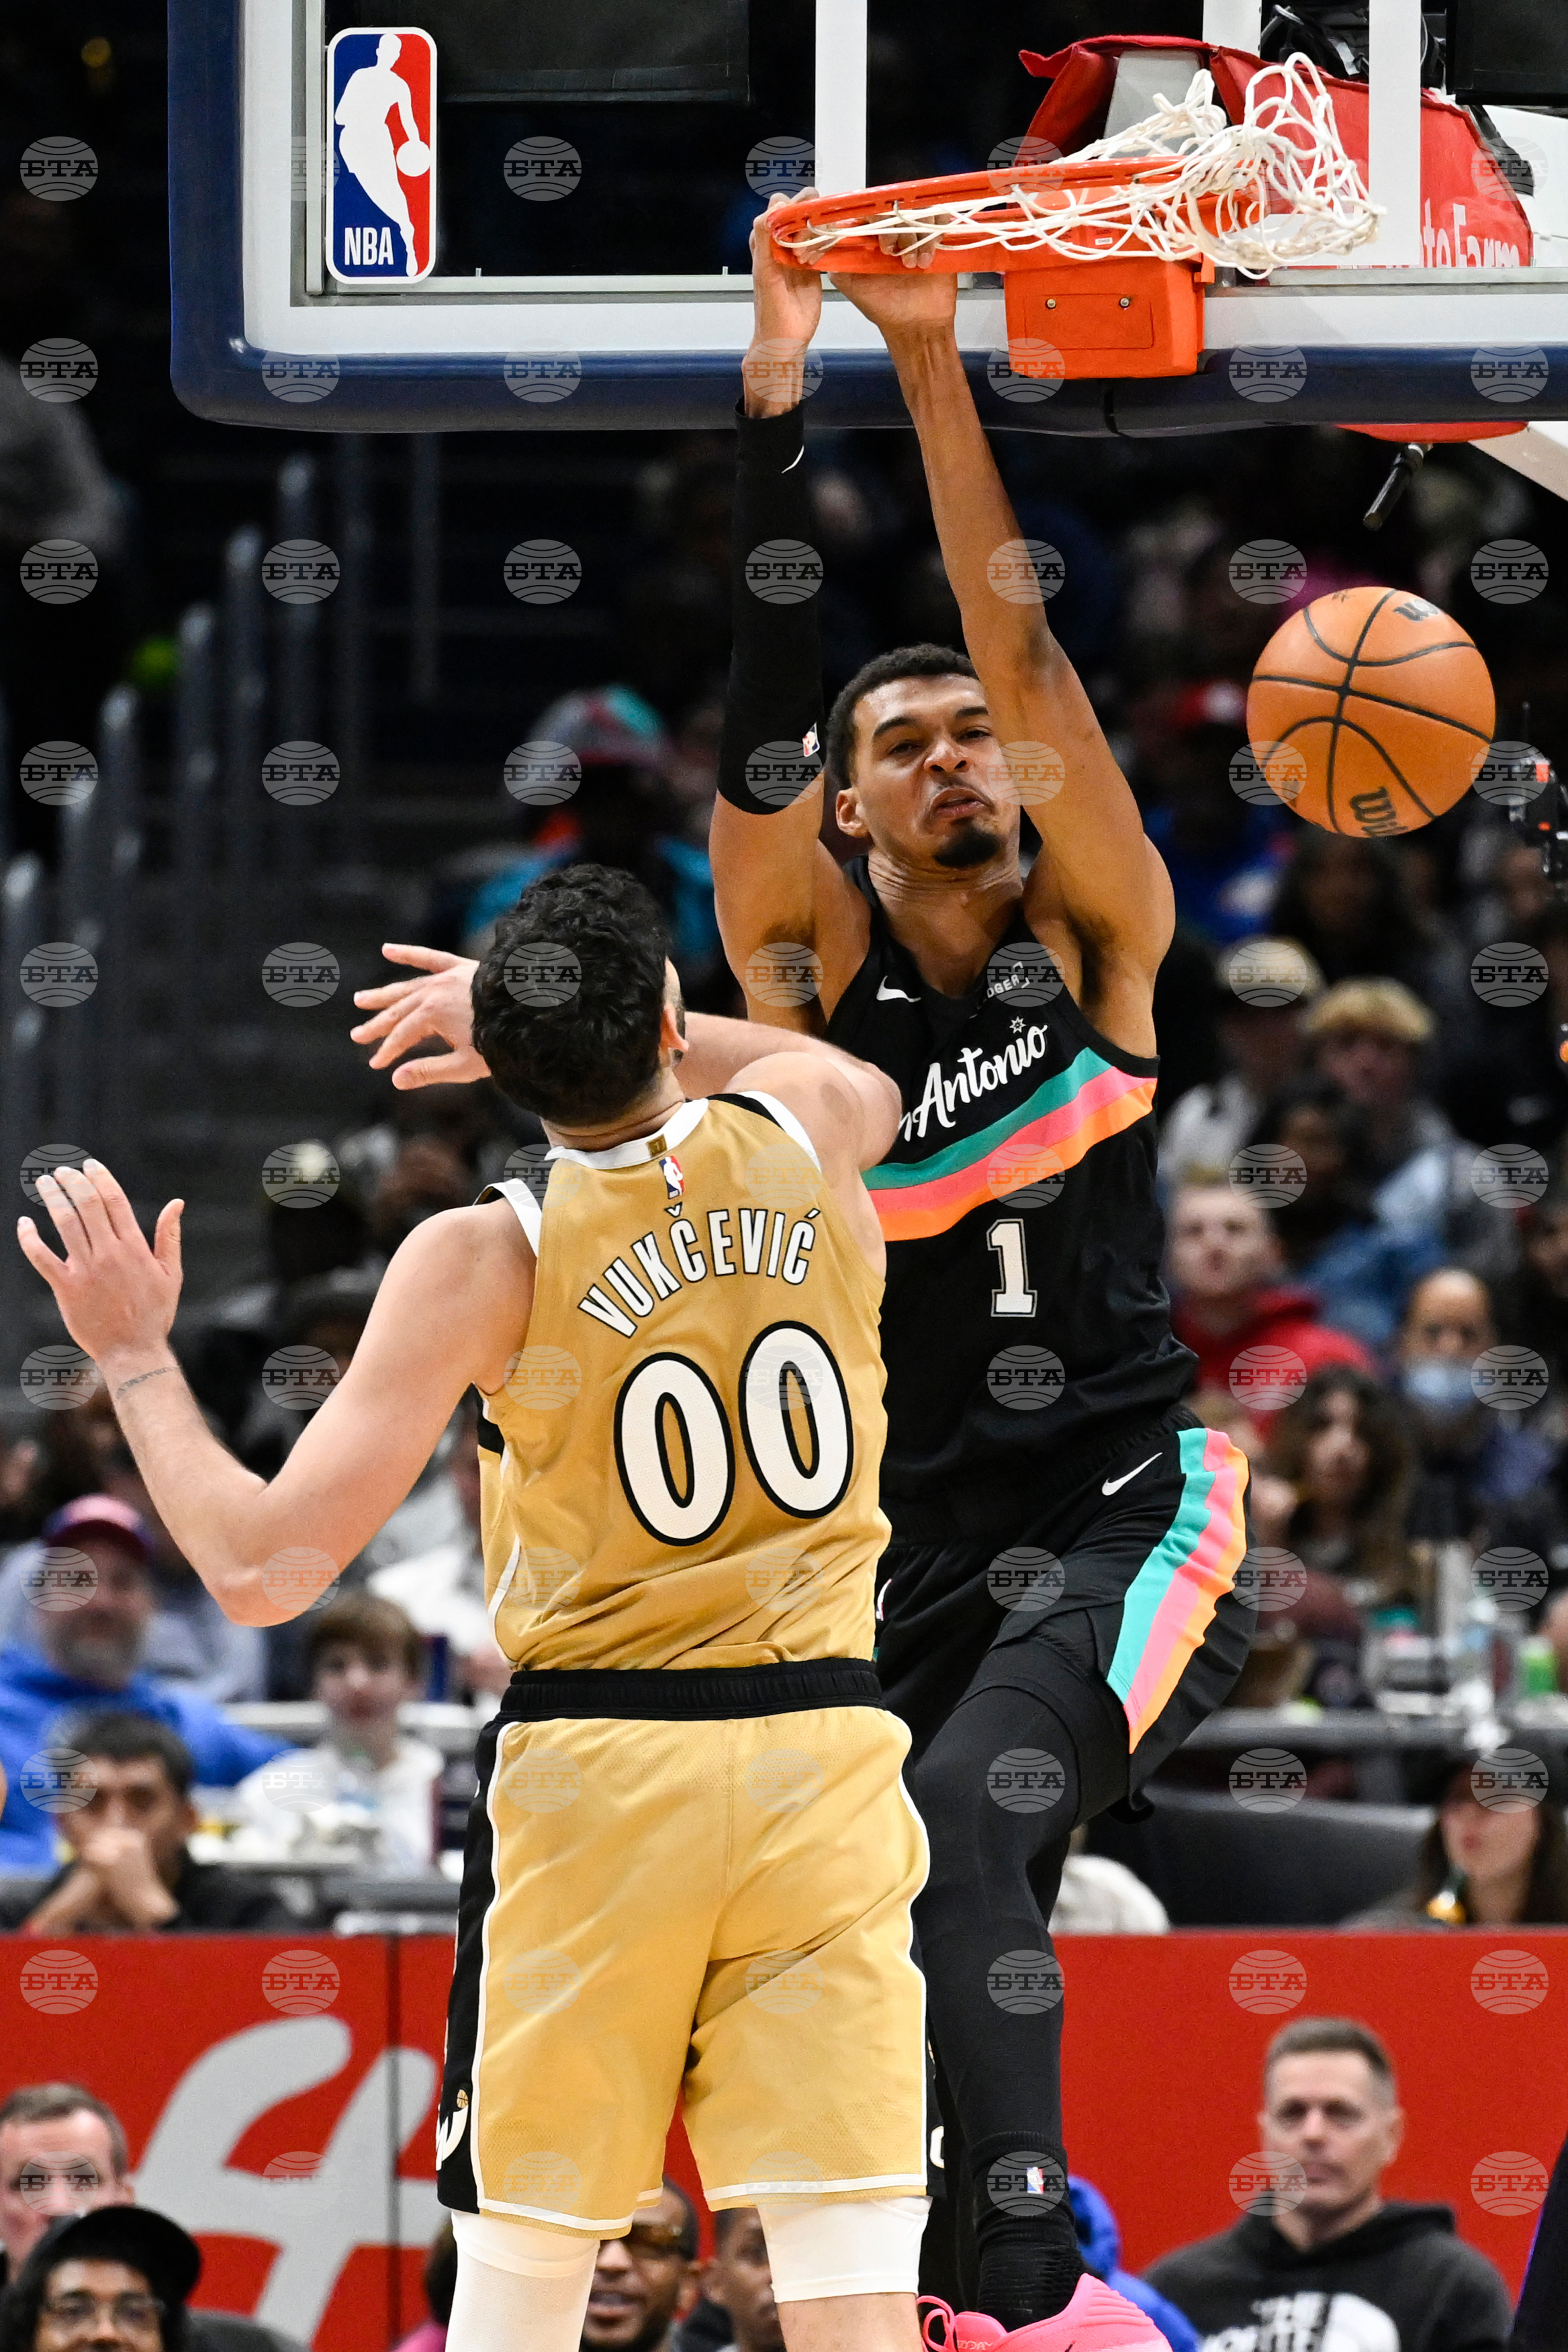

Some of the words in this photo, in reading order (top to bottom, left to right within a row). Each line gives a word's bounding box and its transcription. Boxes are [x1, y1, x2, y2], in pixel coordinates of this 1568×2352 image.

[344, 226, 394, 265] NBA
[986, 974, 1020, 998] DGER
[912, 1024, 1048, 1138] Antonio
[578, 1202, 821, 1339] VUKČEVIĆ
[986, 1218, 1037, 1317] 1
[614, 1320, 854, 1546] 00
